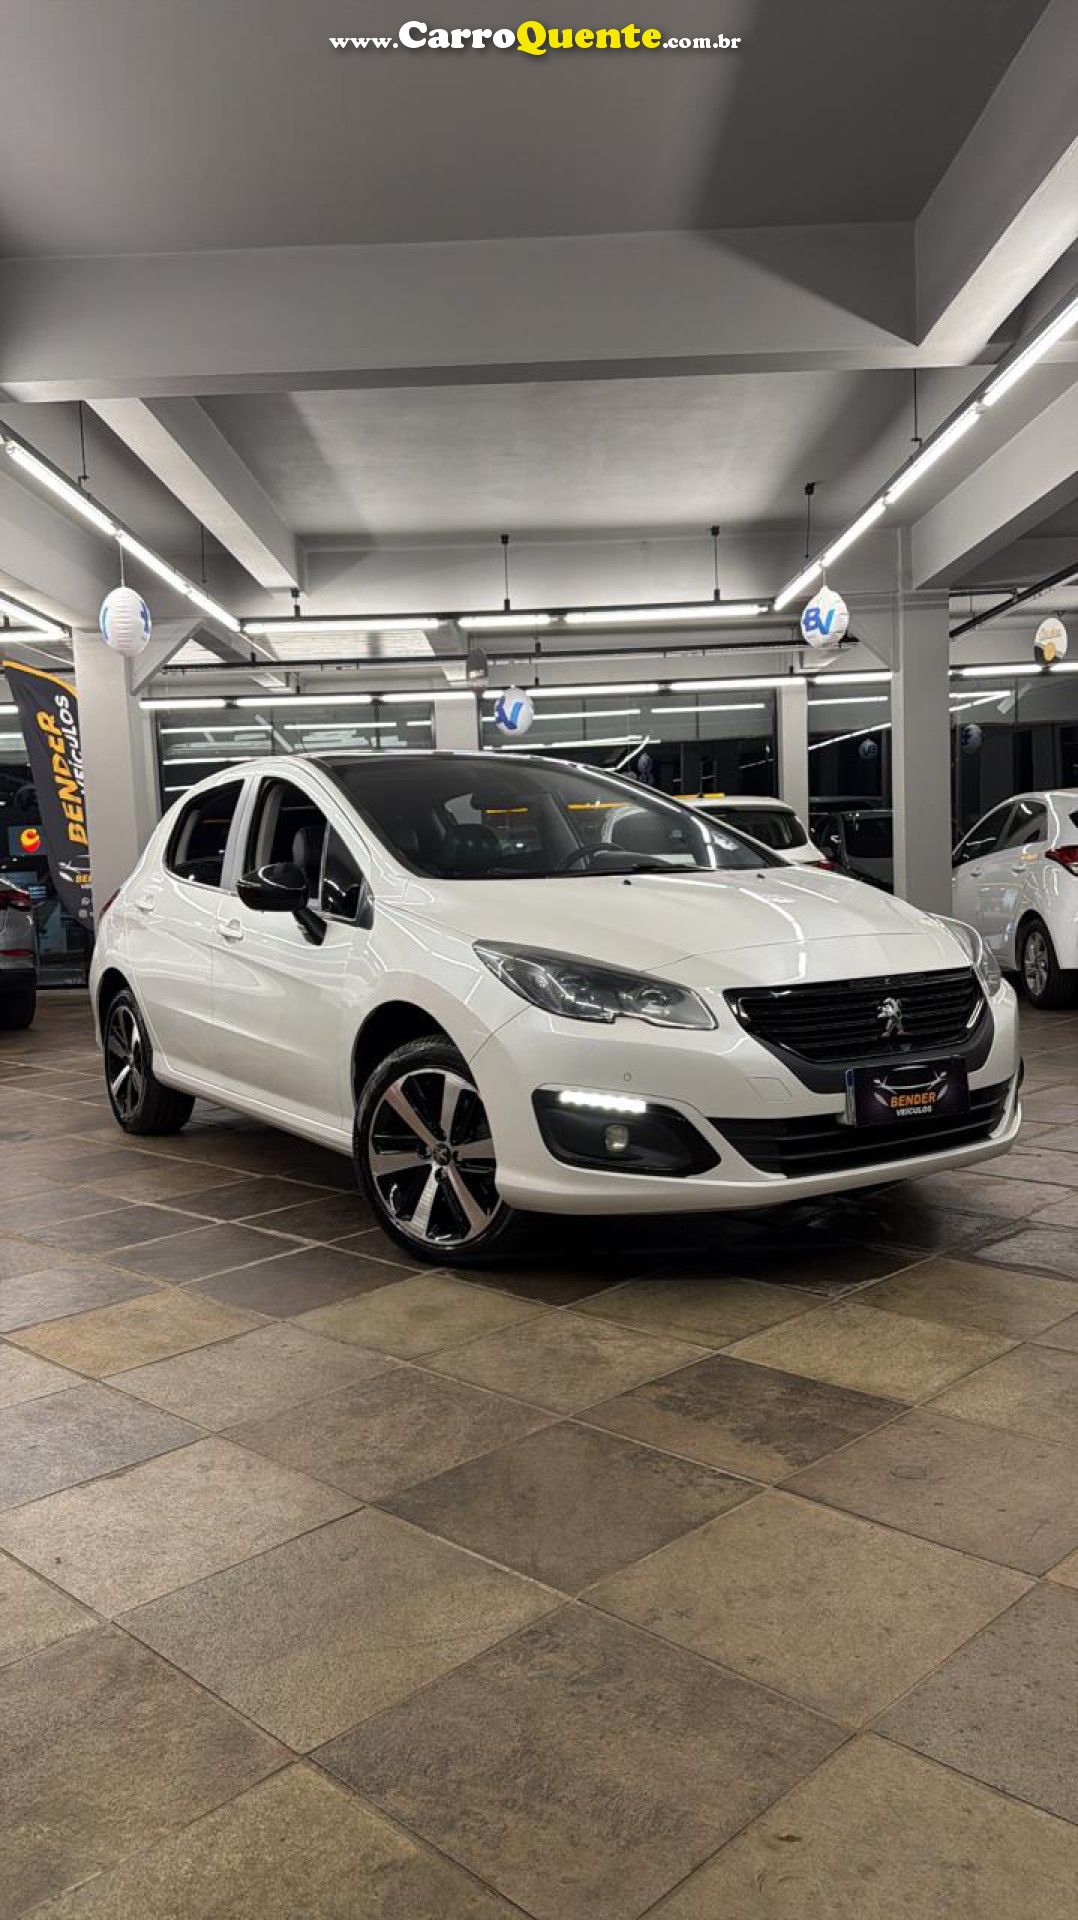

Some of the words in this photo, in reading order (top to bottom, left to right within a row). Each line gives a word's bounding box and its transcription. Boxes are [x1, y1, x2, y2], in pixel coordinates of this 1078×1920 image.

[802, 607, 836, 635] BV
[36, 710, 88, 845] BENDER
[890, 1091, 936, 1108] BENDER
